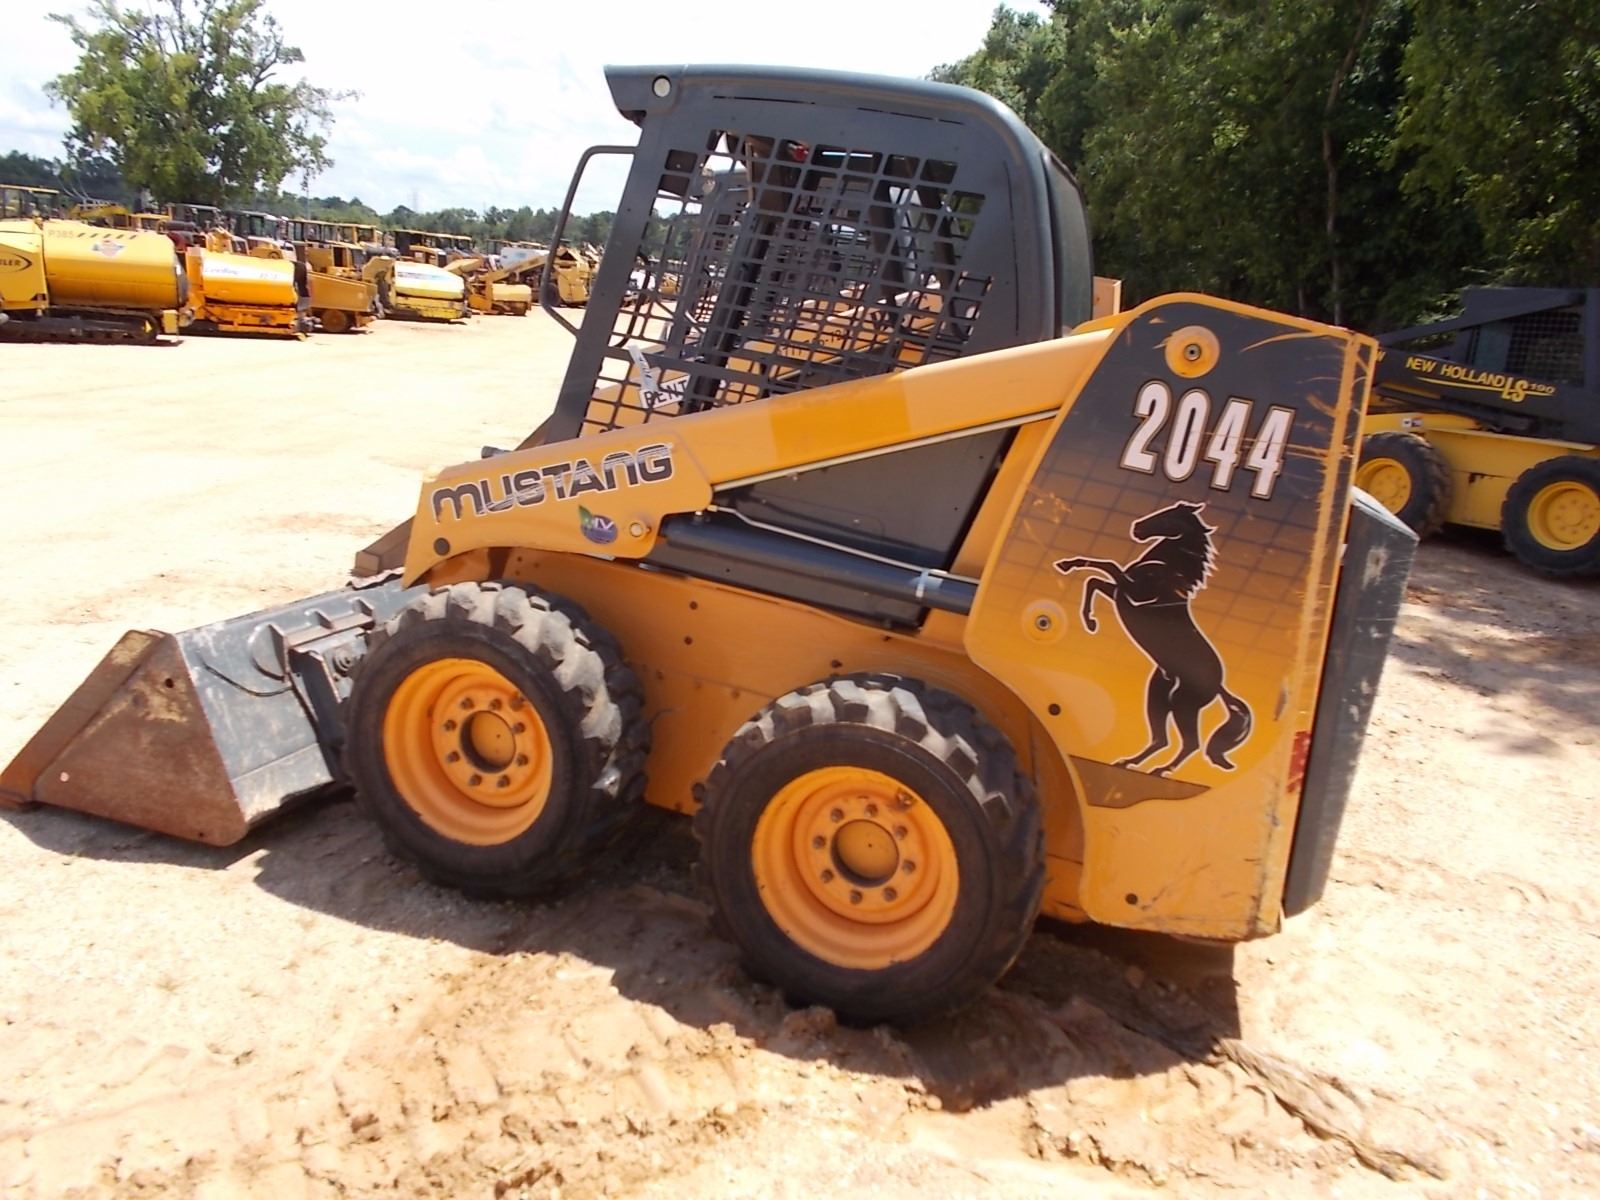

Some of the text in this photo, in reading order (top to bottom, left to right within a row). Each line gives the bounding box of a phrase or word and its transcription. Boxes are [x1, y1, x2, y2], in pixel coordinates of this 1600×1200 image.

[1406, 356, 1438, 373] NEW
[1440, 364, 1505, 388] HOLLAND
[1501, 377, 1528, 402] LS
[1120, 379, 1296, 501] 2044
[432, 443, 675, 524] MUSTANG
